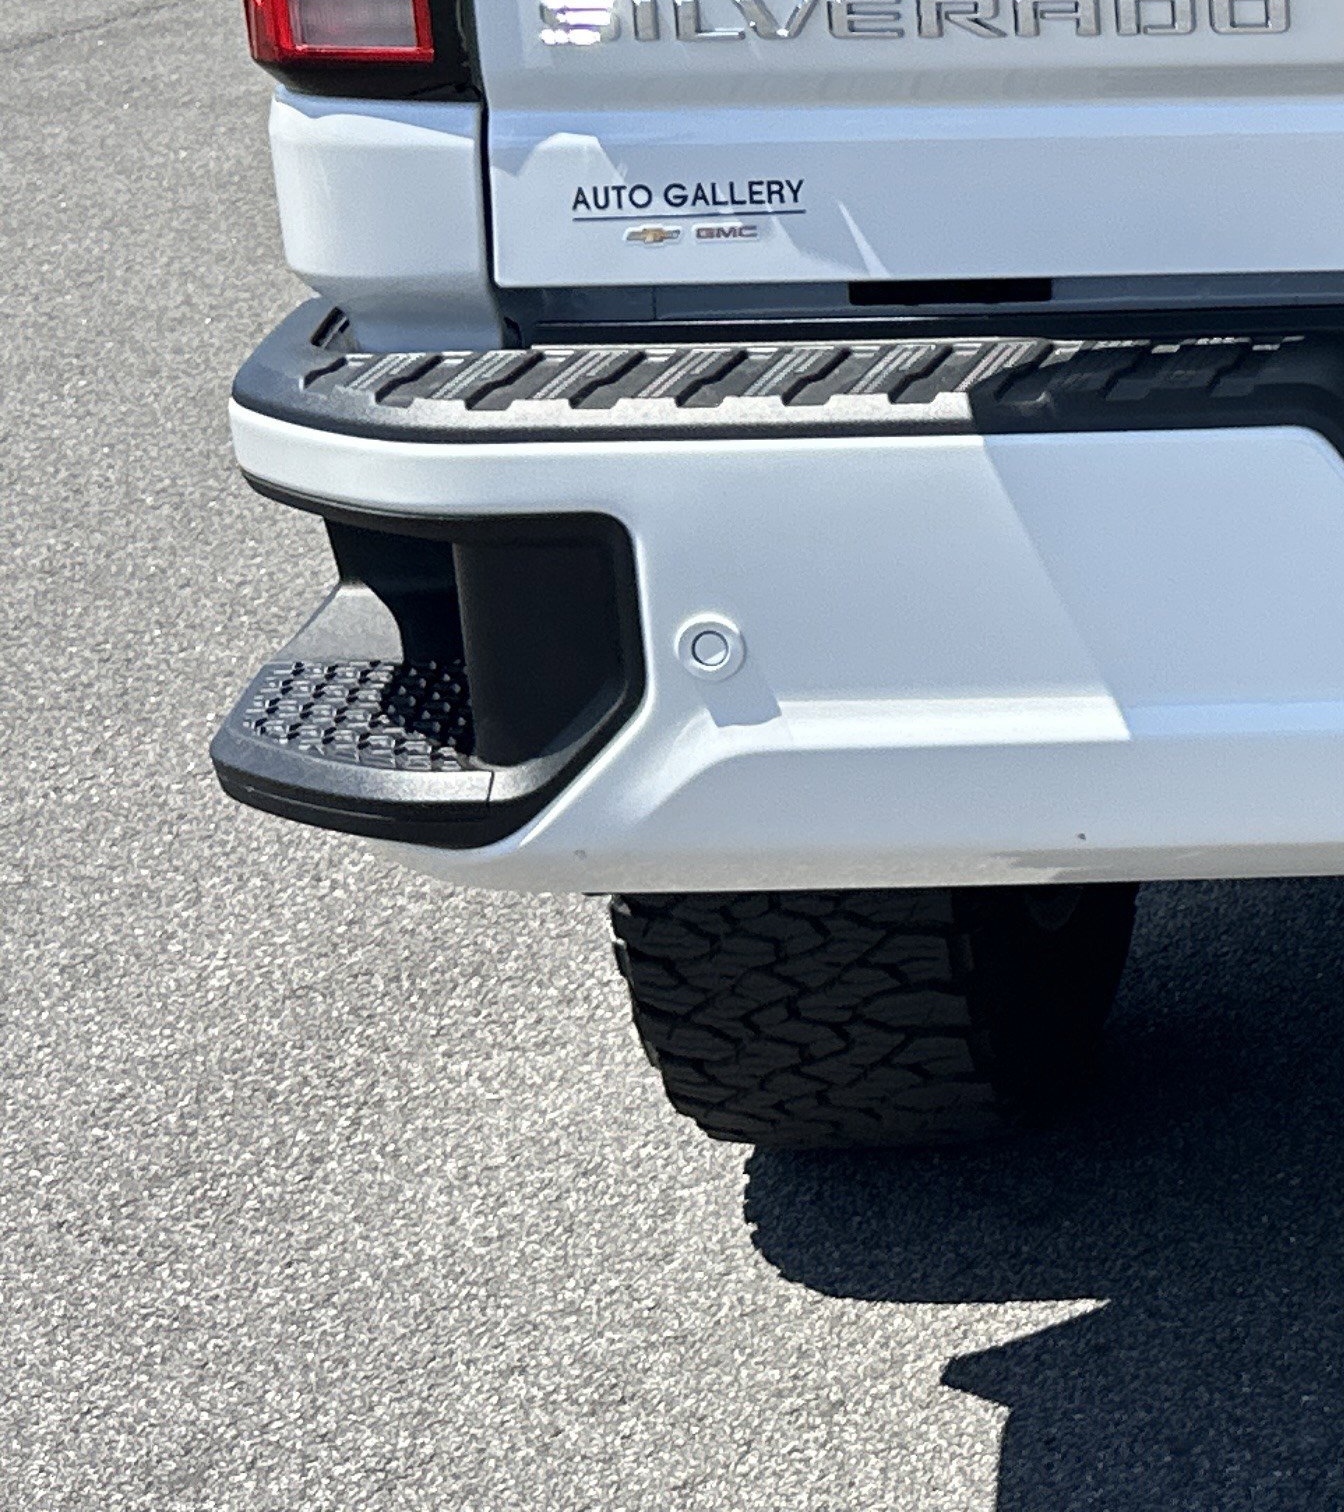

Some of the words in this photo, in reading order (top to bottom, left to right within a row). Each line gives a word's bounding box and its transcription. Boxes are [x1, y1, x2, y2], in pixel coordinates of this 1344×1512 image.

[572, 184, 654, 212] AUTO
[663, 178, 805, 208] GALLERY
[695, 224, 759, 240] GMC
